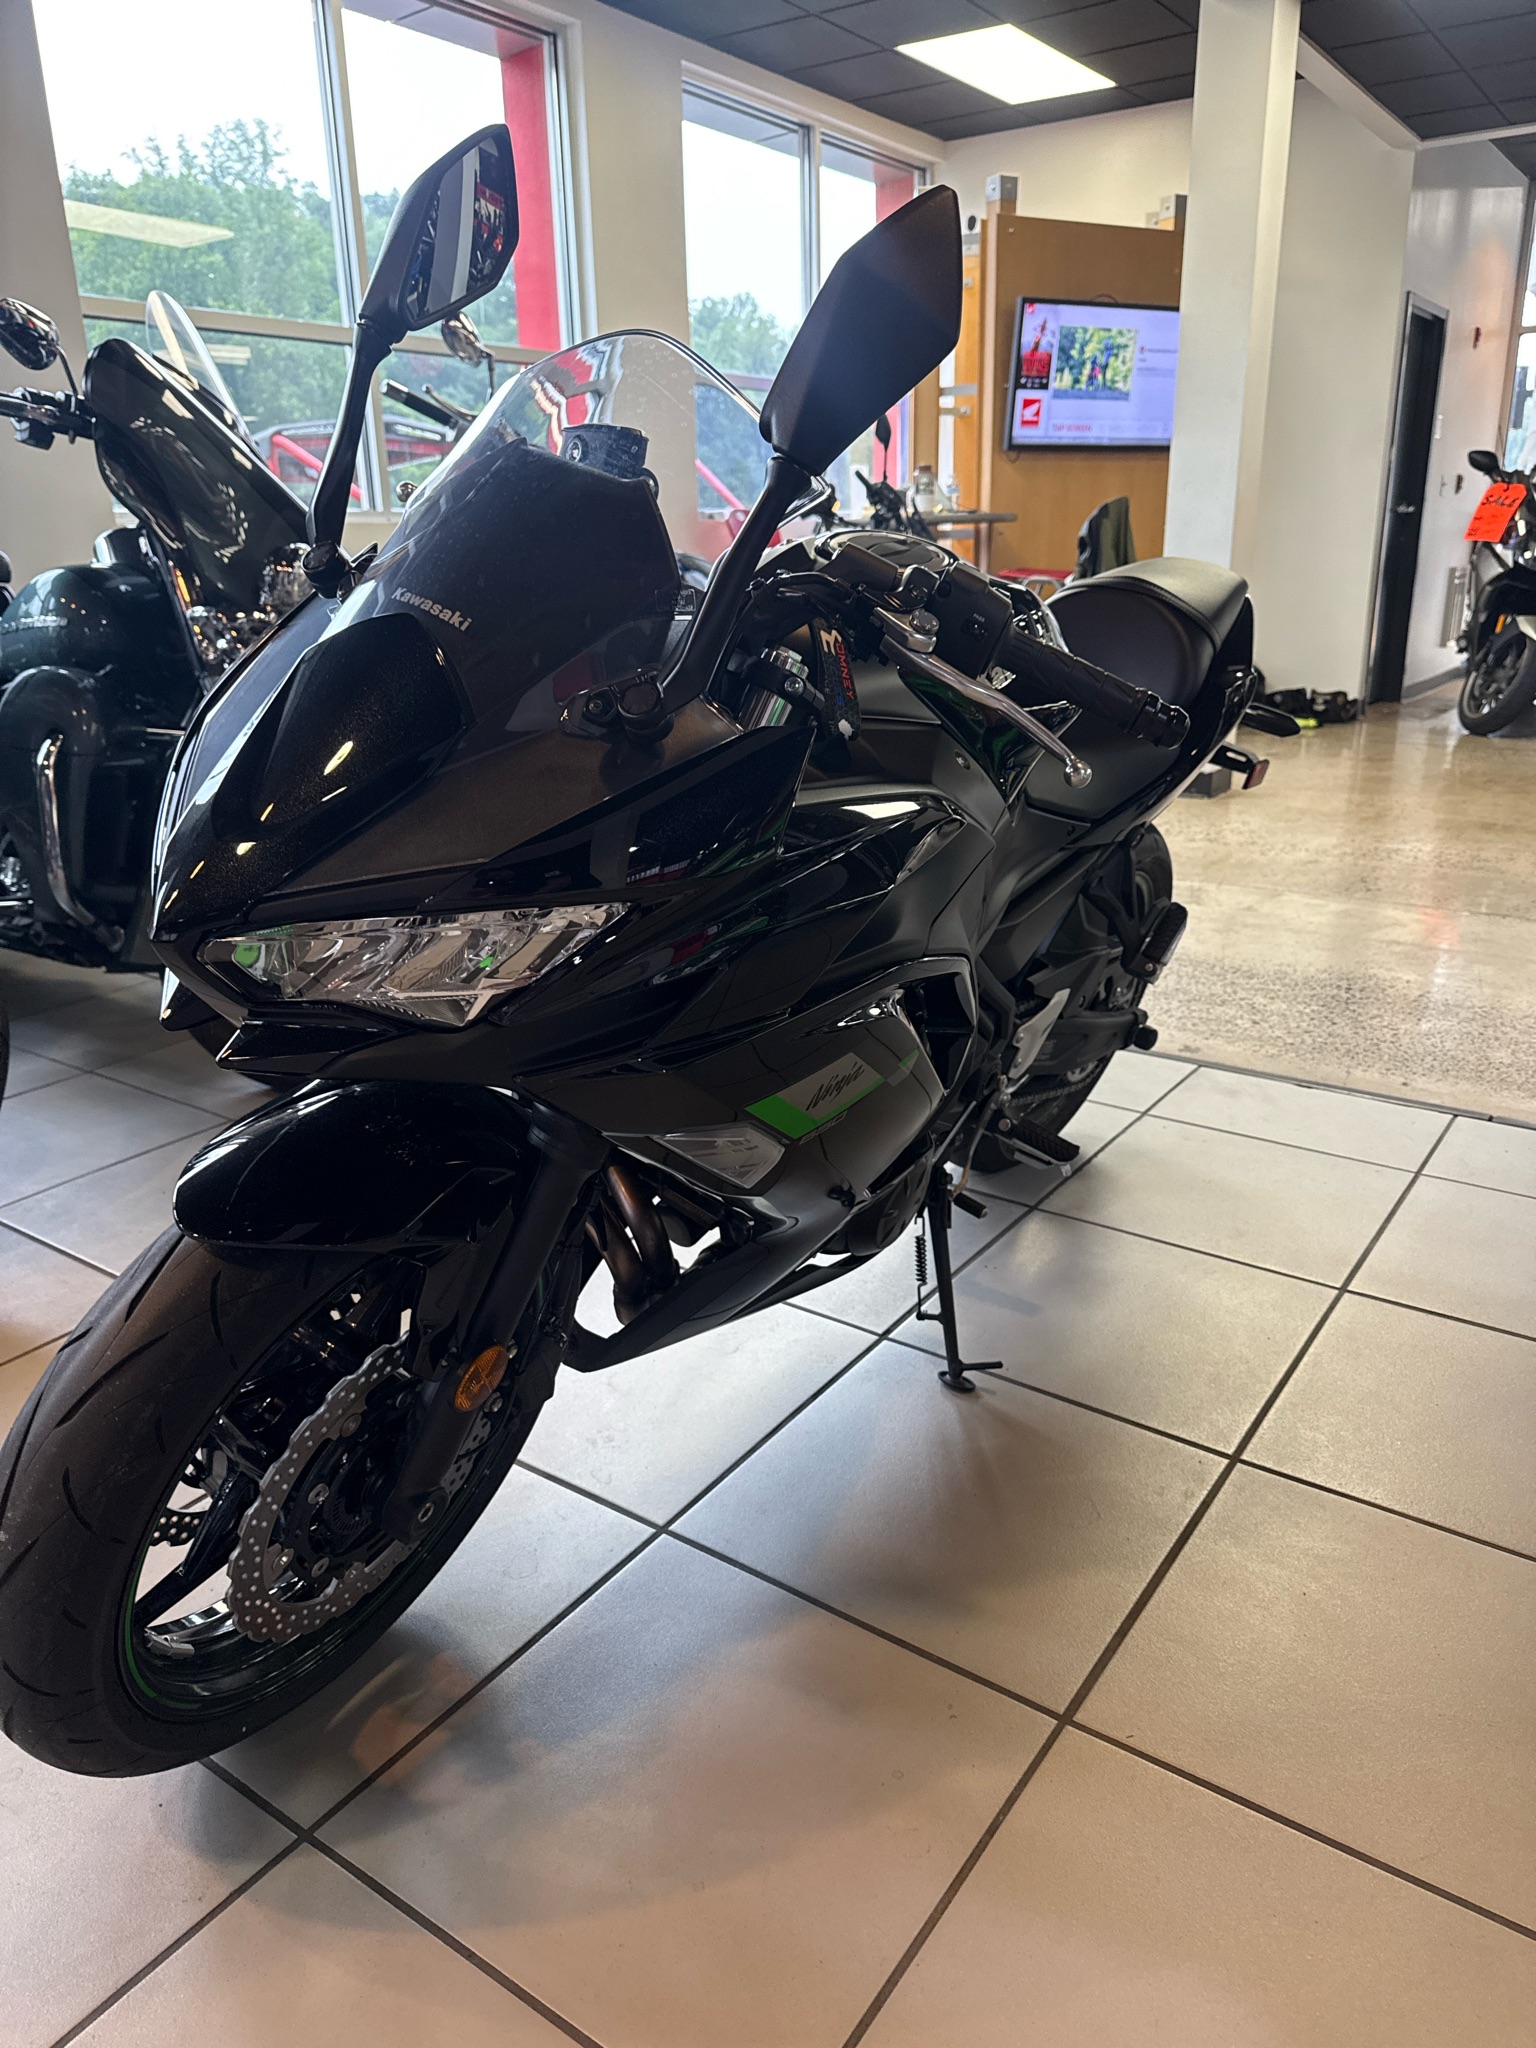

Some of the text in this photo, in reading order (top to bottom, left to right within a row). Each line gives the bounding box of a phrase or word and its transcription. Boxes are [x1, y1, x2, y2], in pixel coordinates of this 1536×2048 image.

[391, 587, 472, 632] Kawasaki
[972, 613, 986, 623] PASS
[805, 1061, 866, 1112] Ninja
[799, 1110, 848, 1146] 650
